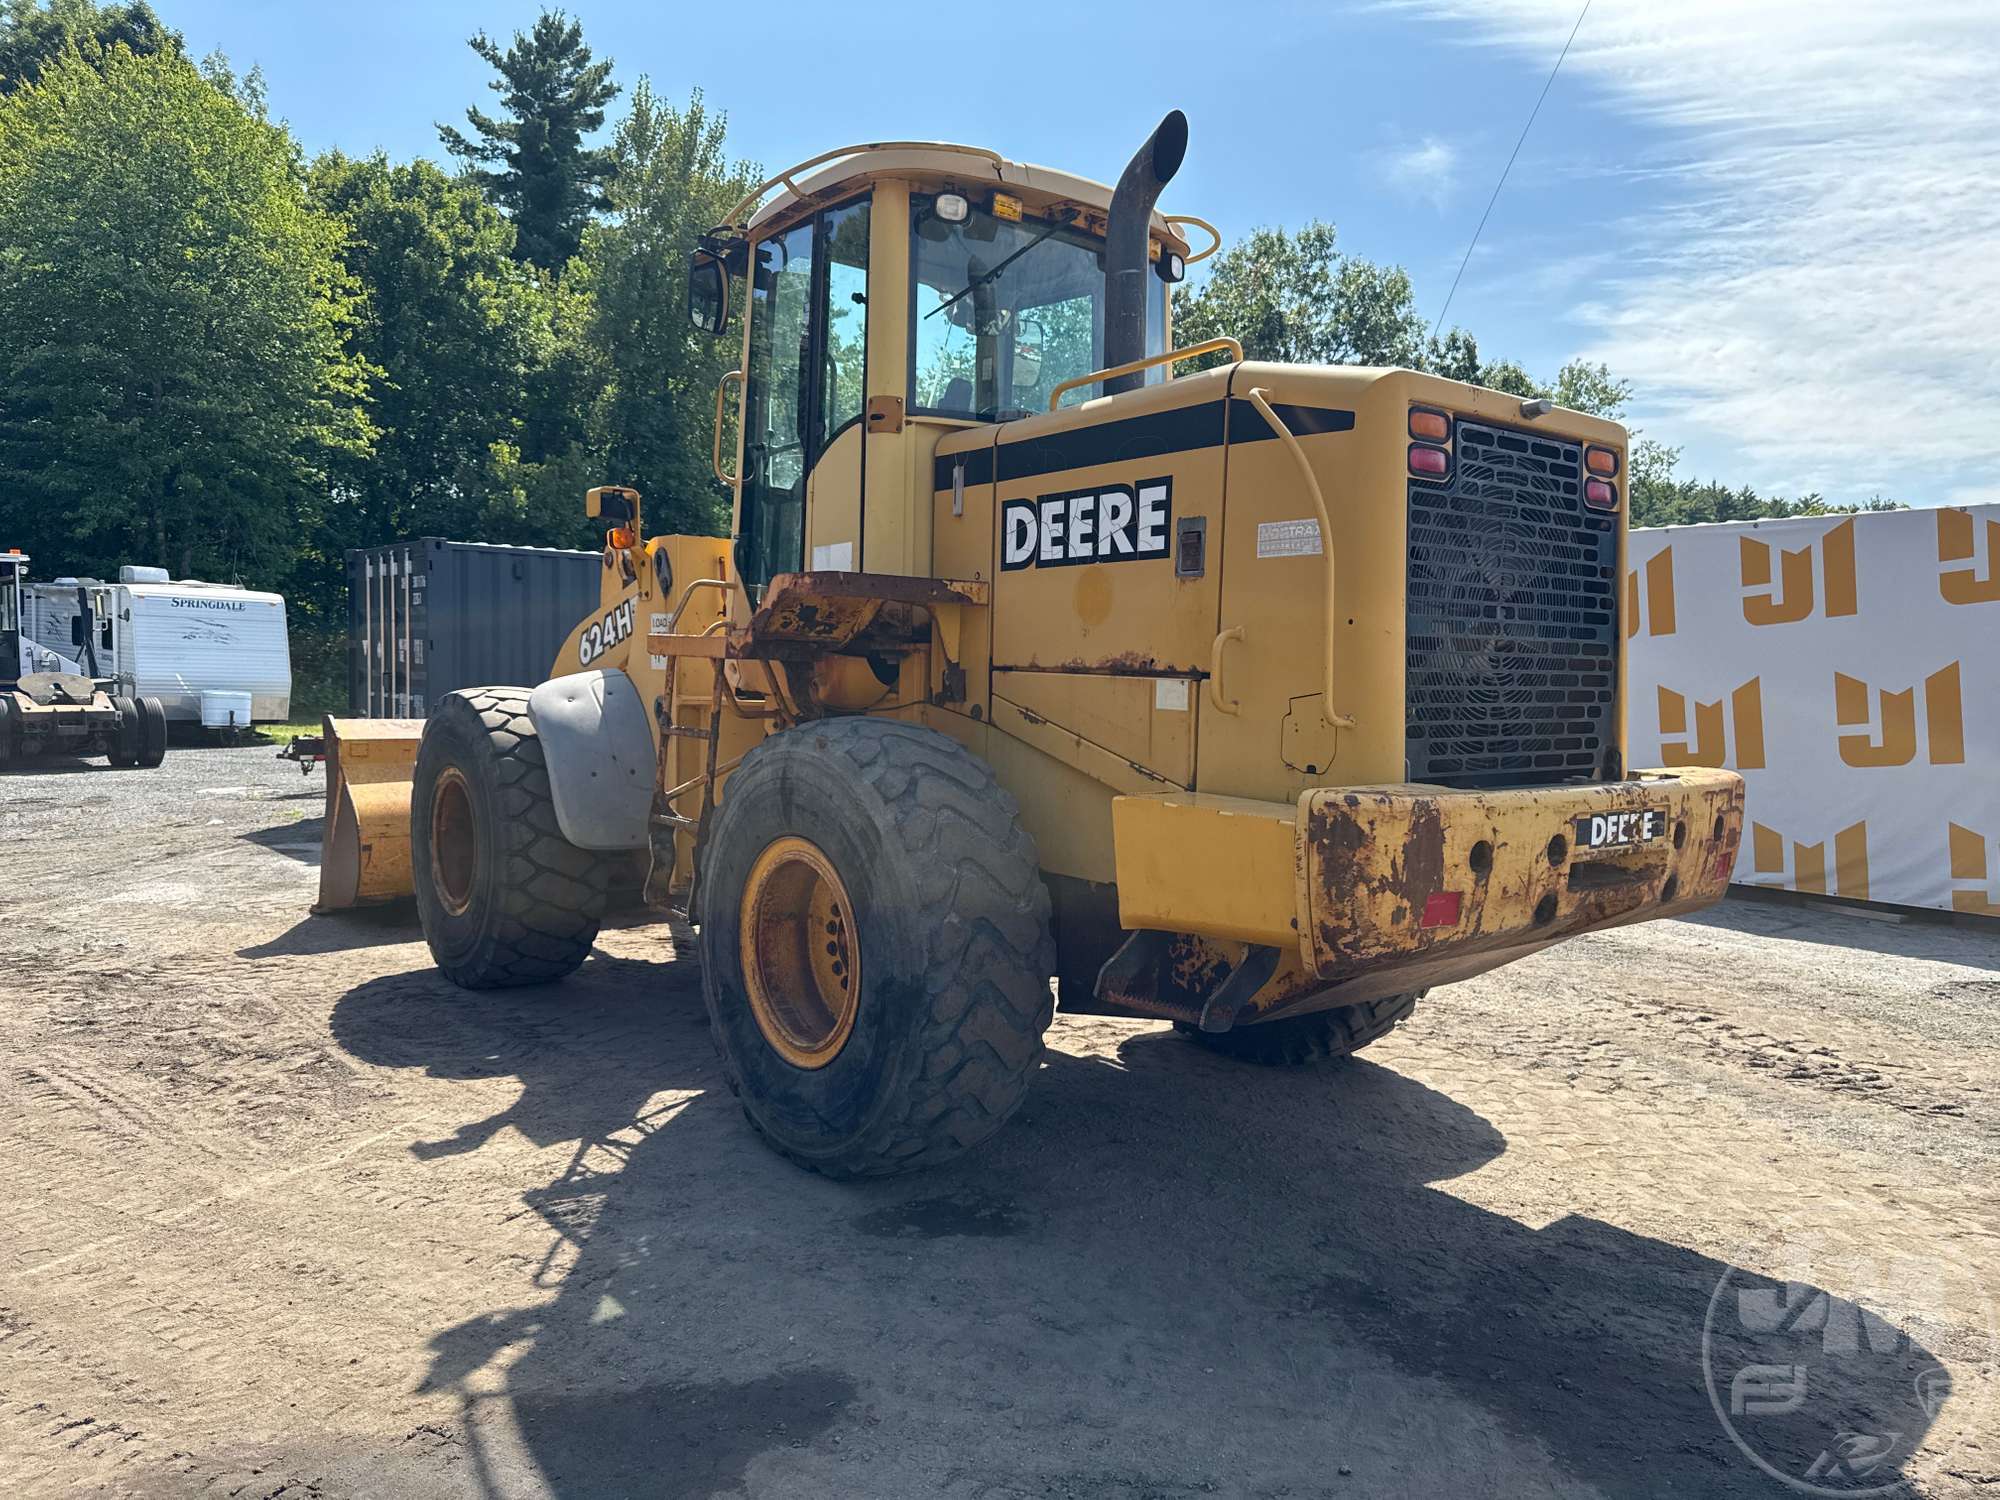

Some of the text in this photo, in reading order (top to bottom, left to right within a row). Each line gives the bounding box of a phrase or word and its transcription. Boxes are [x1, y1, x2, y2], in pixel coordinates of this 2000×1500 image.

[1005, 485, 1168, 565] DEERE
[170, 597, 247, 612] SPRINGDALE
[579, 600, 633, 666] 624H
